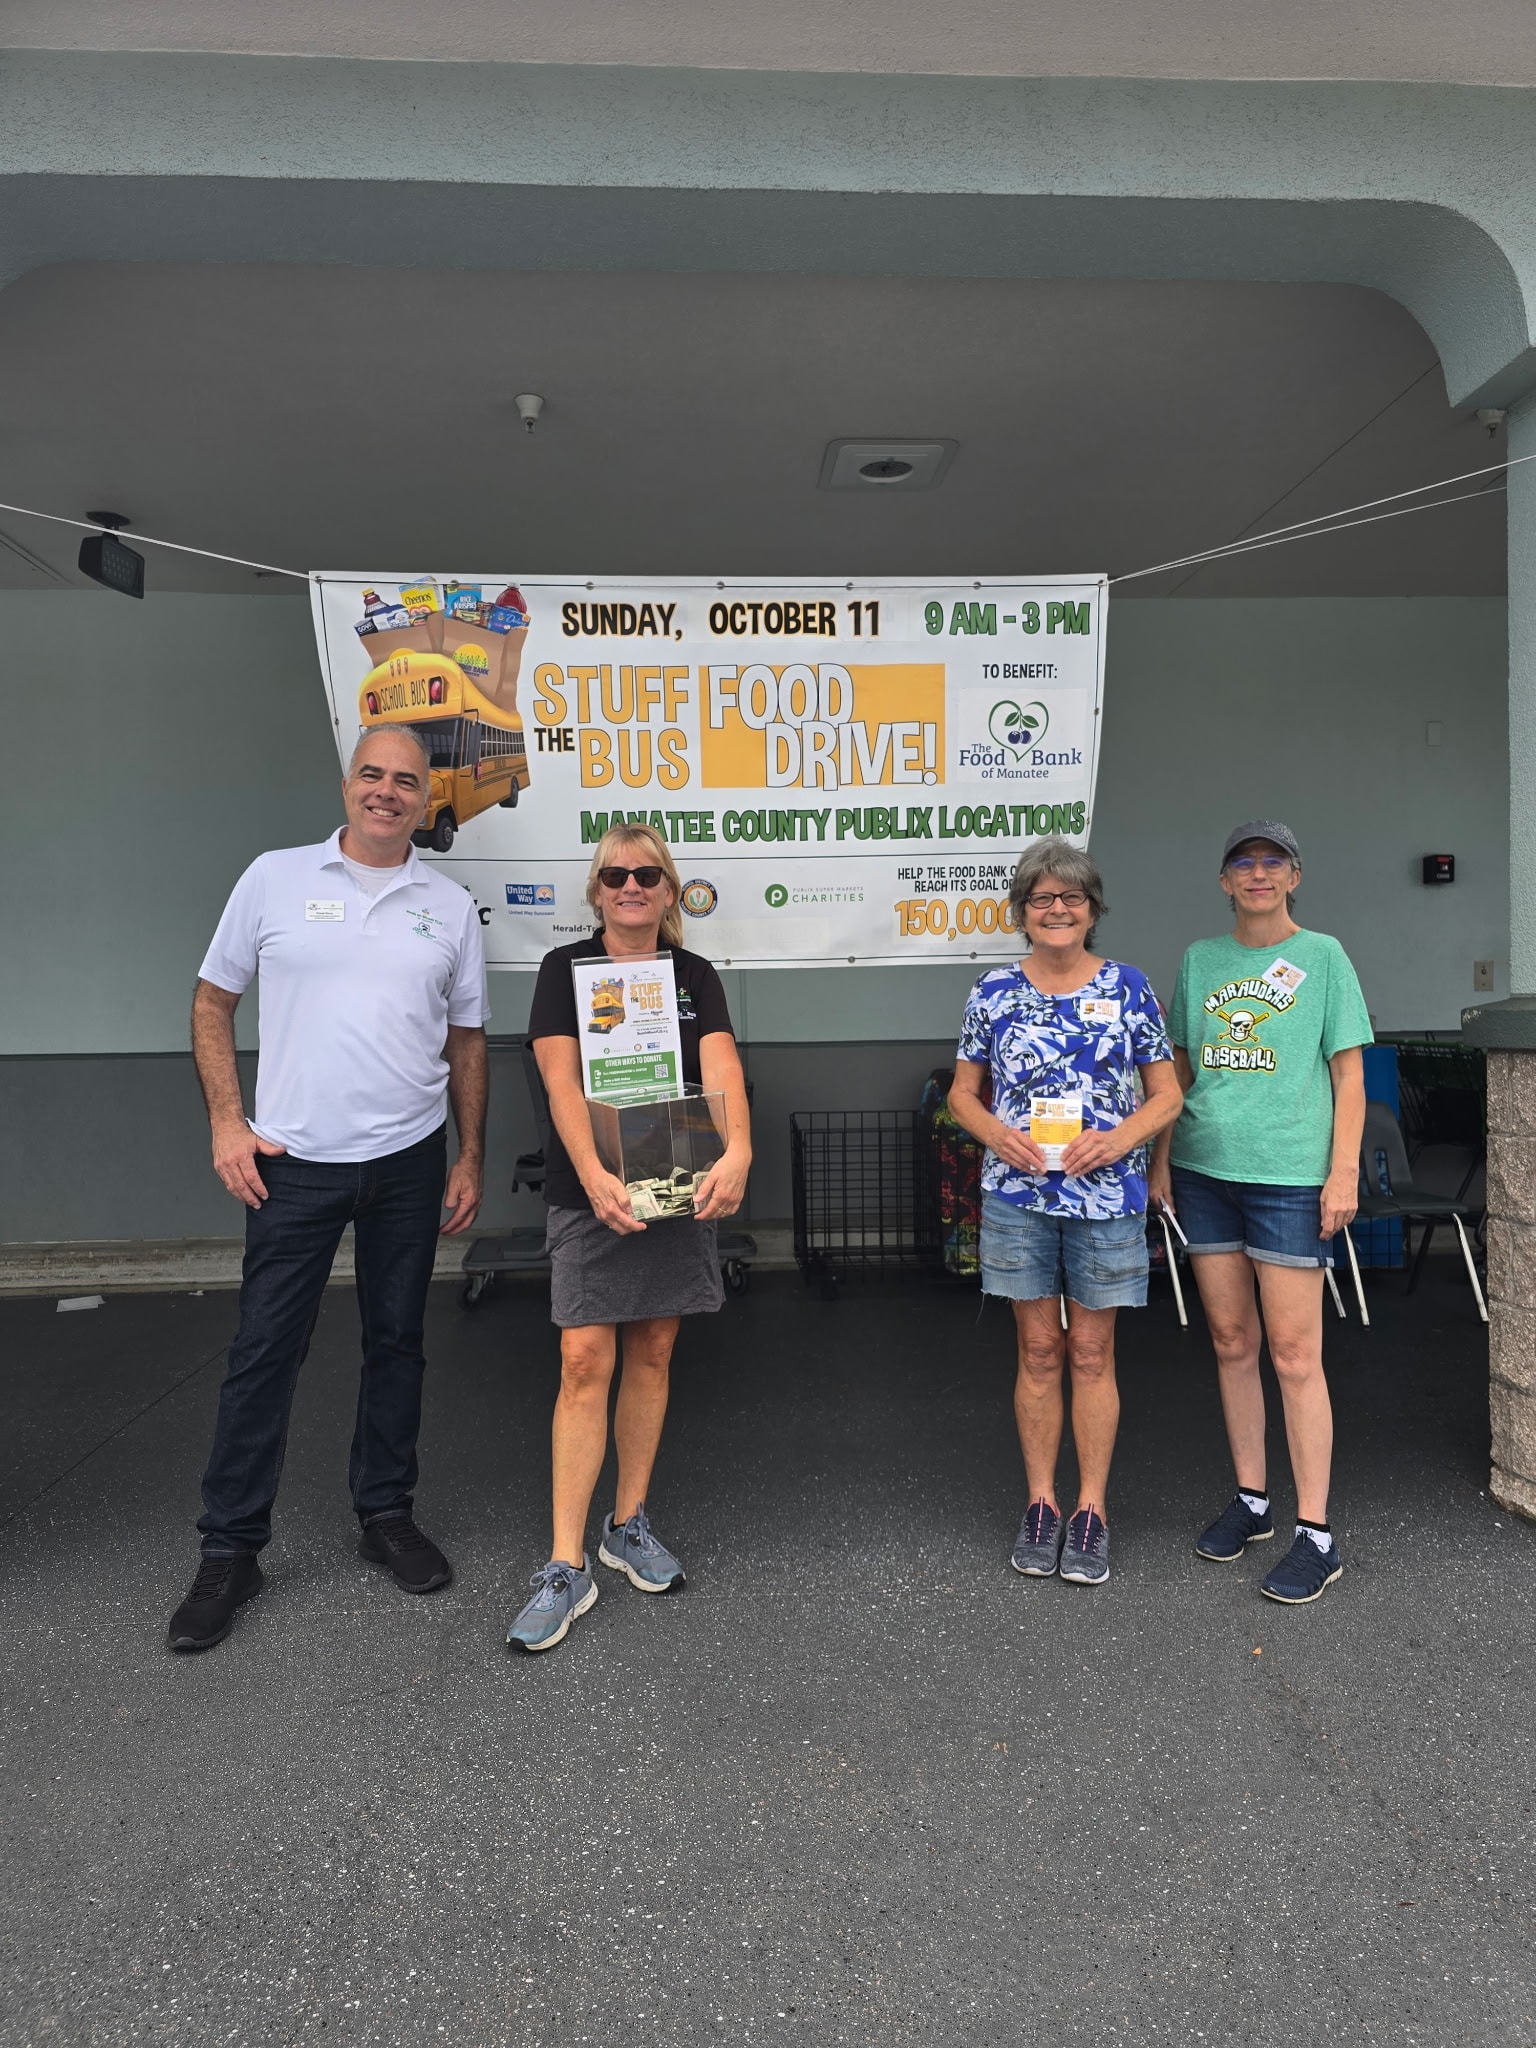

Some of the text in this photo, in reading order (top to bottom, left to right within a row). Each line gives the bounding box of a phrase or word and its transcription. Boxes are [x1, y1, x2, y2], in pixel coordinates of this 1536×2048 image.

[562, 601, 880, 641] SUNDAY, OCTOBER 11
[924, 601, 944, 635] 9
[950, 602, 997, 635] AM
[1022, 602, 1040, 634] 3
[1046, 601, 1090, 635] PM
[982, 664, 1058, 679] TO BENEFIT:
[380, 679, 426, 711] SCHOOL BUS
[533, 663, 689, 726] STUFF
[708, 663, 854, 730] FOOD
[765, 720, 938, 791] DRIVE!
[971, 743, 991, 753] The
[534, 727, 690, 790] THE BUS
[959, 748, 1082, 766] Food Bank
[981, 768, 1049, 778] of Manatee
[723, 808, 831, 842] COUNTY
[836, 806, 933, 840] PUBLIX
[938, 801, 1086, 839] LOCATIONS
[898, 867, 923, 880] HELP
[927, 867, 946, 879] THE
[949, 866, 976, 878] FOOD
[979, 865, 1007, 877] BANK
[507, 886, 533, 895] United
[914, 880, 948, 893] REACH
[951, 880, 967, 892] ITS
[970, 879, 998, 891] GOAL
[517, 895, 533, 904] Way
[792, 893, 864, 903] CHARITIES
[630, 982, 662, 997] STUFF
[1204, 979, 1294, 1013] MARAUDERS
[639, 996, 663, 1010] BUS
[605, 1054, 662, 1067] OTHER WAYS TO DONATE
[1203, 1045, 1276, 1071] BASEBALL
